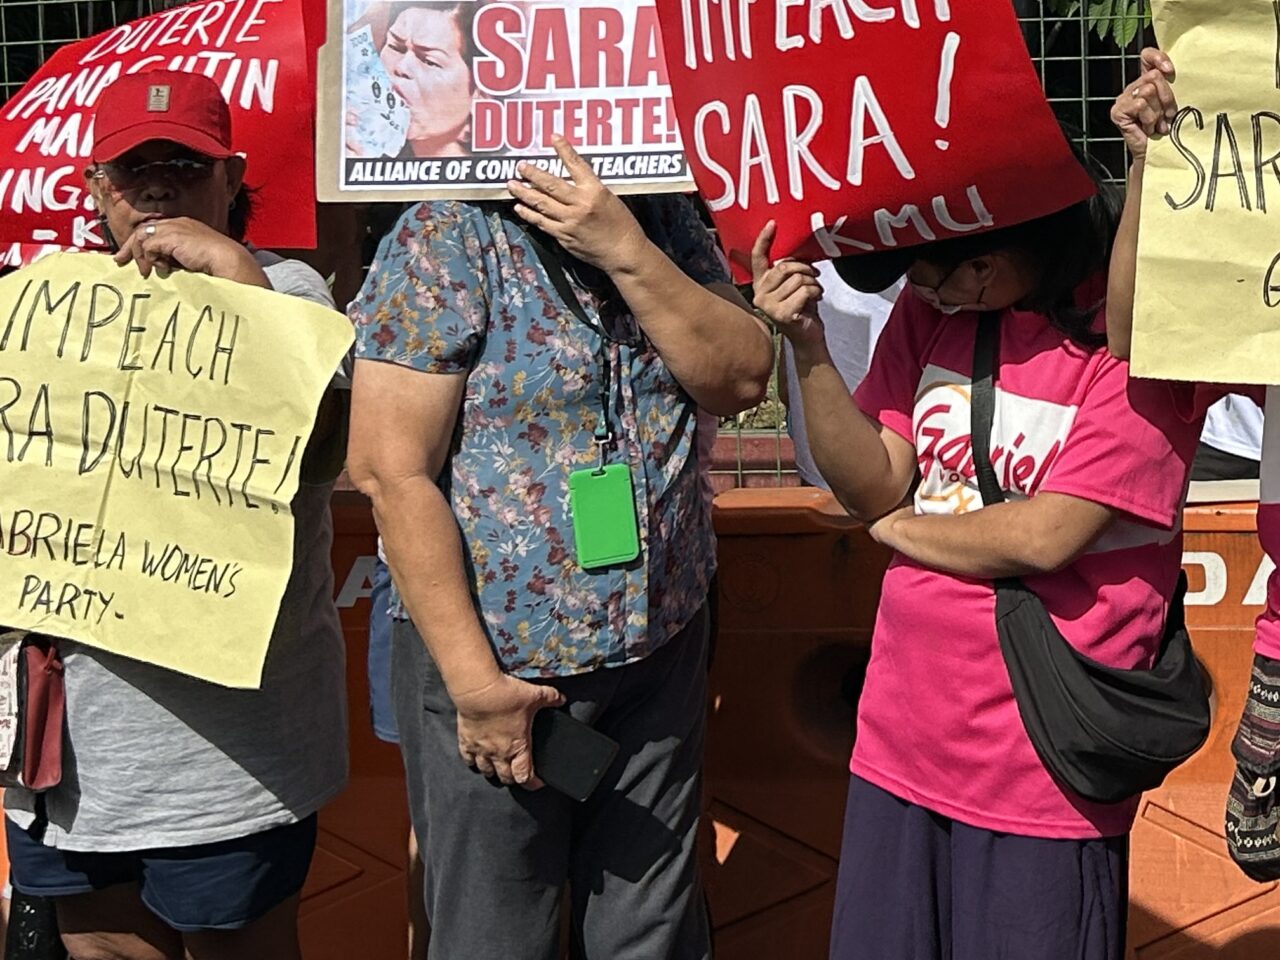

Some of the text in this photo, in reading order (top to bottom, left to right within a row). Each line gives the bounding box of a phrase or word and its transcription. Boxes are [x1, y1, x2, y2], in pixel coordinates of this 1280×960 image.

[477, 6, 670, 91] SARA
[475, 96, 677, 150] DUTERTE!
[349, 159, 441, 182] ALLIANCE
[446, 159, 472, 180] OF
[591, 153, 682, 176] TEACHERS
[810, 184, 994, 257] KMU
[0, 279, 239, 385] IMPEACH
[79, 390, 302, 515] DUTERTE!
[143, 539, 243, 598] WOMEN'S
